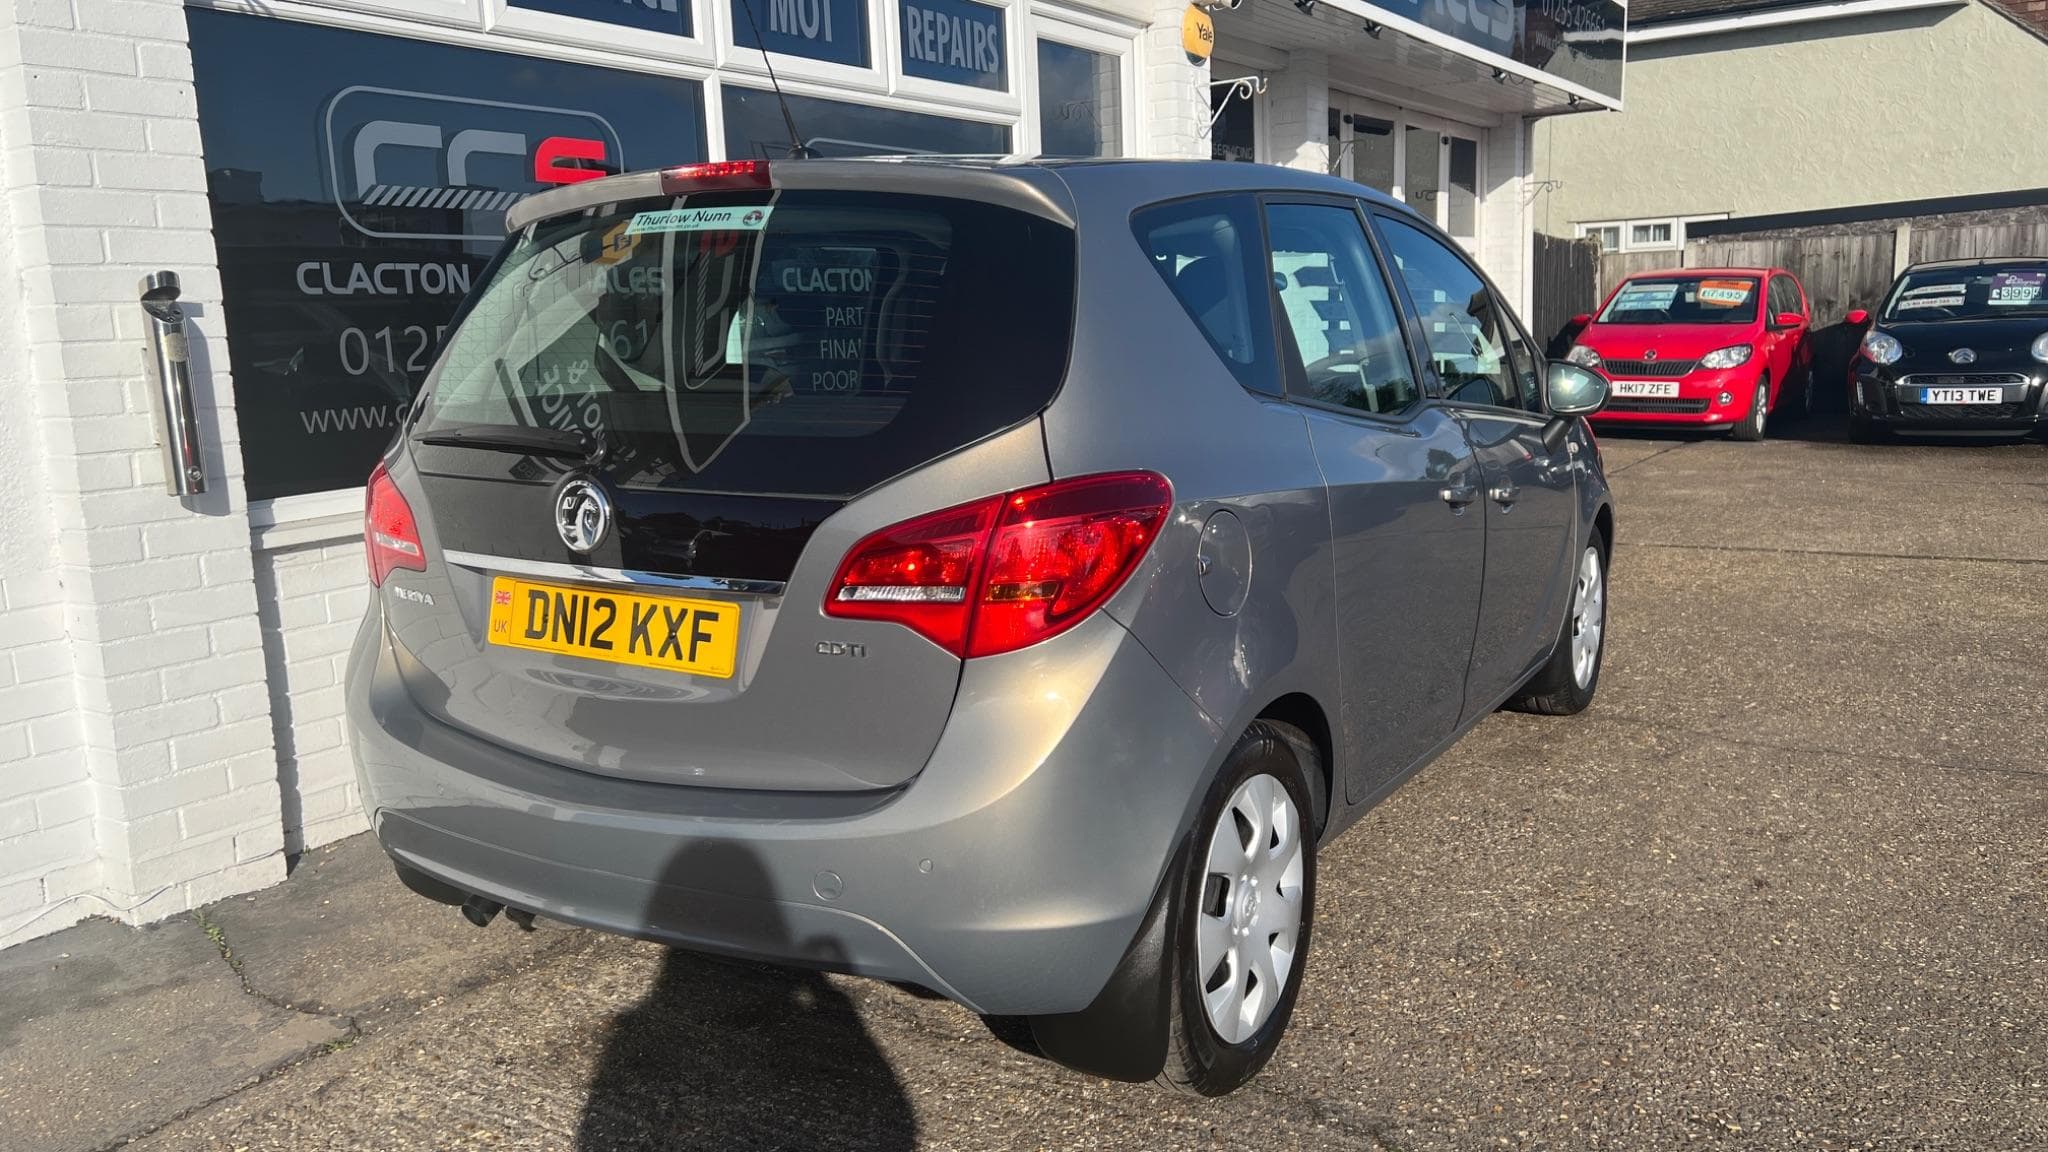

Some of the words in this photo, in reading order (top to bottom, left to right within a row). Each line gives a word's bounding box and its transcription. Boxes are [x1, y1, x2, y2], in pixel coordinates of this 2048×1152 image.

[769, 0, 833, 43] MOT
[1196, 21, 1213, 43] Yale
[906, 7, 1000, 75] REPAIRS
[636, 213, 691, 227] Thurlow
[692, 209, 732, 222] Nunn
[295, 261, 471, 297] CLACTON
[811, 369, 859, 392] POOR
[1619, 383, 1646, 394] HK17
[1648, 383, 1671, 395] ZFE
[1932, 389, 1964, 402] YT13
[1968, 389, 1997, 402] TWE
[493, 618, 507, 634] UK
[524, 588, 617, 651] DN12
[628, 602, 720, 663] KXF
